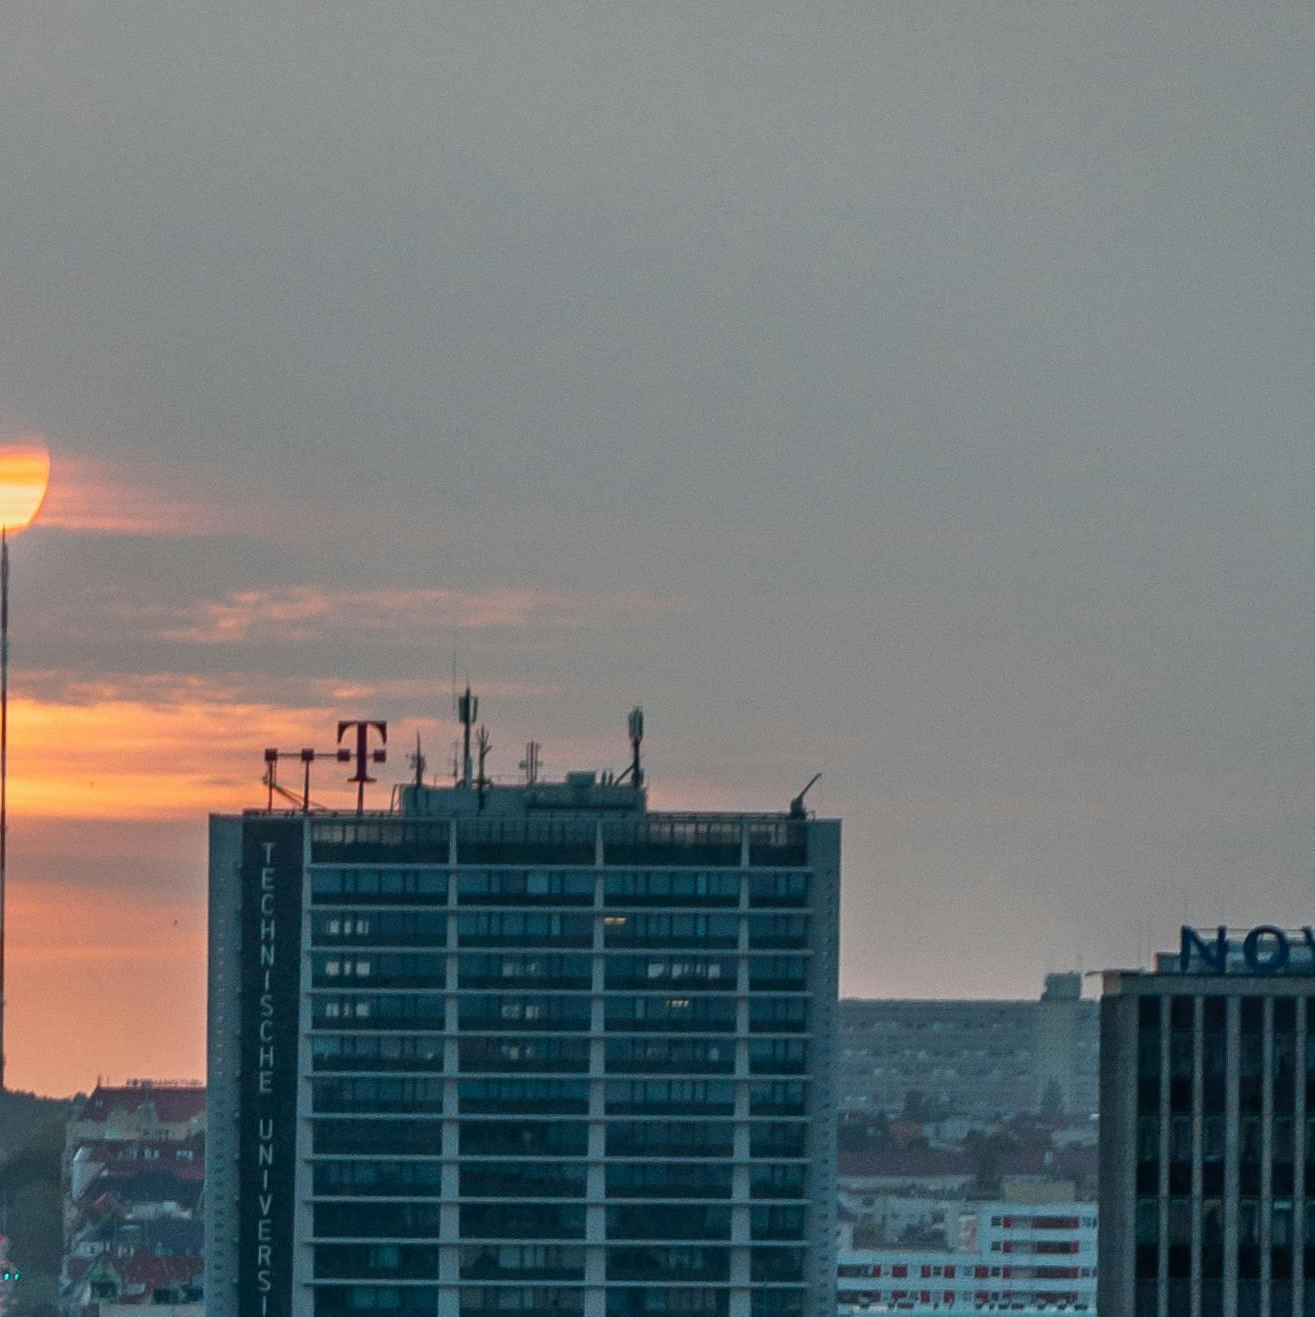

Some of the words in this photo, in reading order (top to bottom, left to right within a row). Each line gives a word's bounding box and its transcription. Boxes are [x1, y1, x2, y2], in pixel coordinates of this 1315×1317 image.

[337, 720, 387, 782] T
[259, 842, 276, 1093] TECHNISCHE
[1180, 924, 1315, 975] NO
